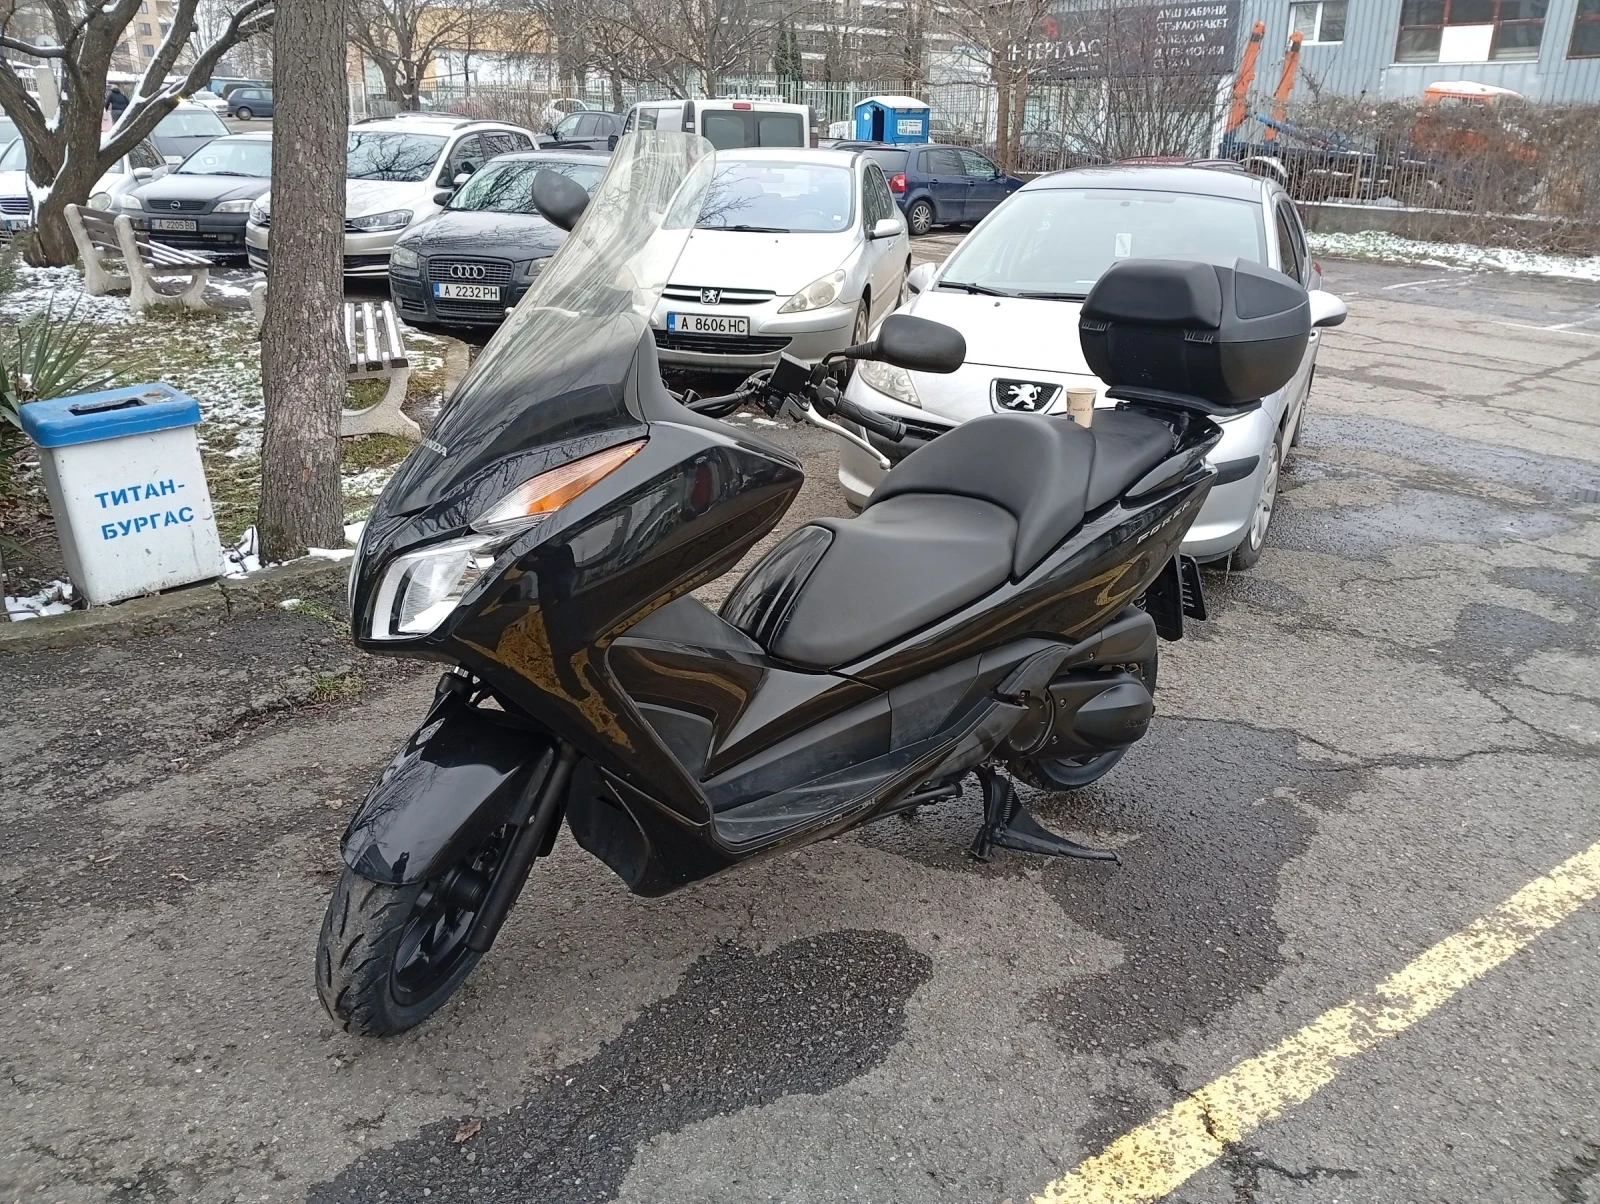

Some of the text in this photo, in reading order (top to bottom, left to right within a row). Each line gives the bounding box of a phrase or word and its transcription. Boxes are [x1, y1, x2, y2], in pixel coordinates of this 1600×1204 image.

[1157, 5, 1227, 20] ДУШ КАБИНИ
[444, 285, 498, 299] A 2232 PH
[681, 316, 689, 330] A
[695, 317, 726, 332] 8606
[728, 319, 746, 333] HC
[94, 479, 185, 509] ТИТАН-
[101, 506, 194, 541] БУРГАС
